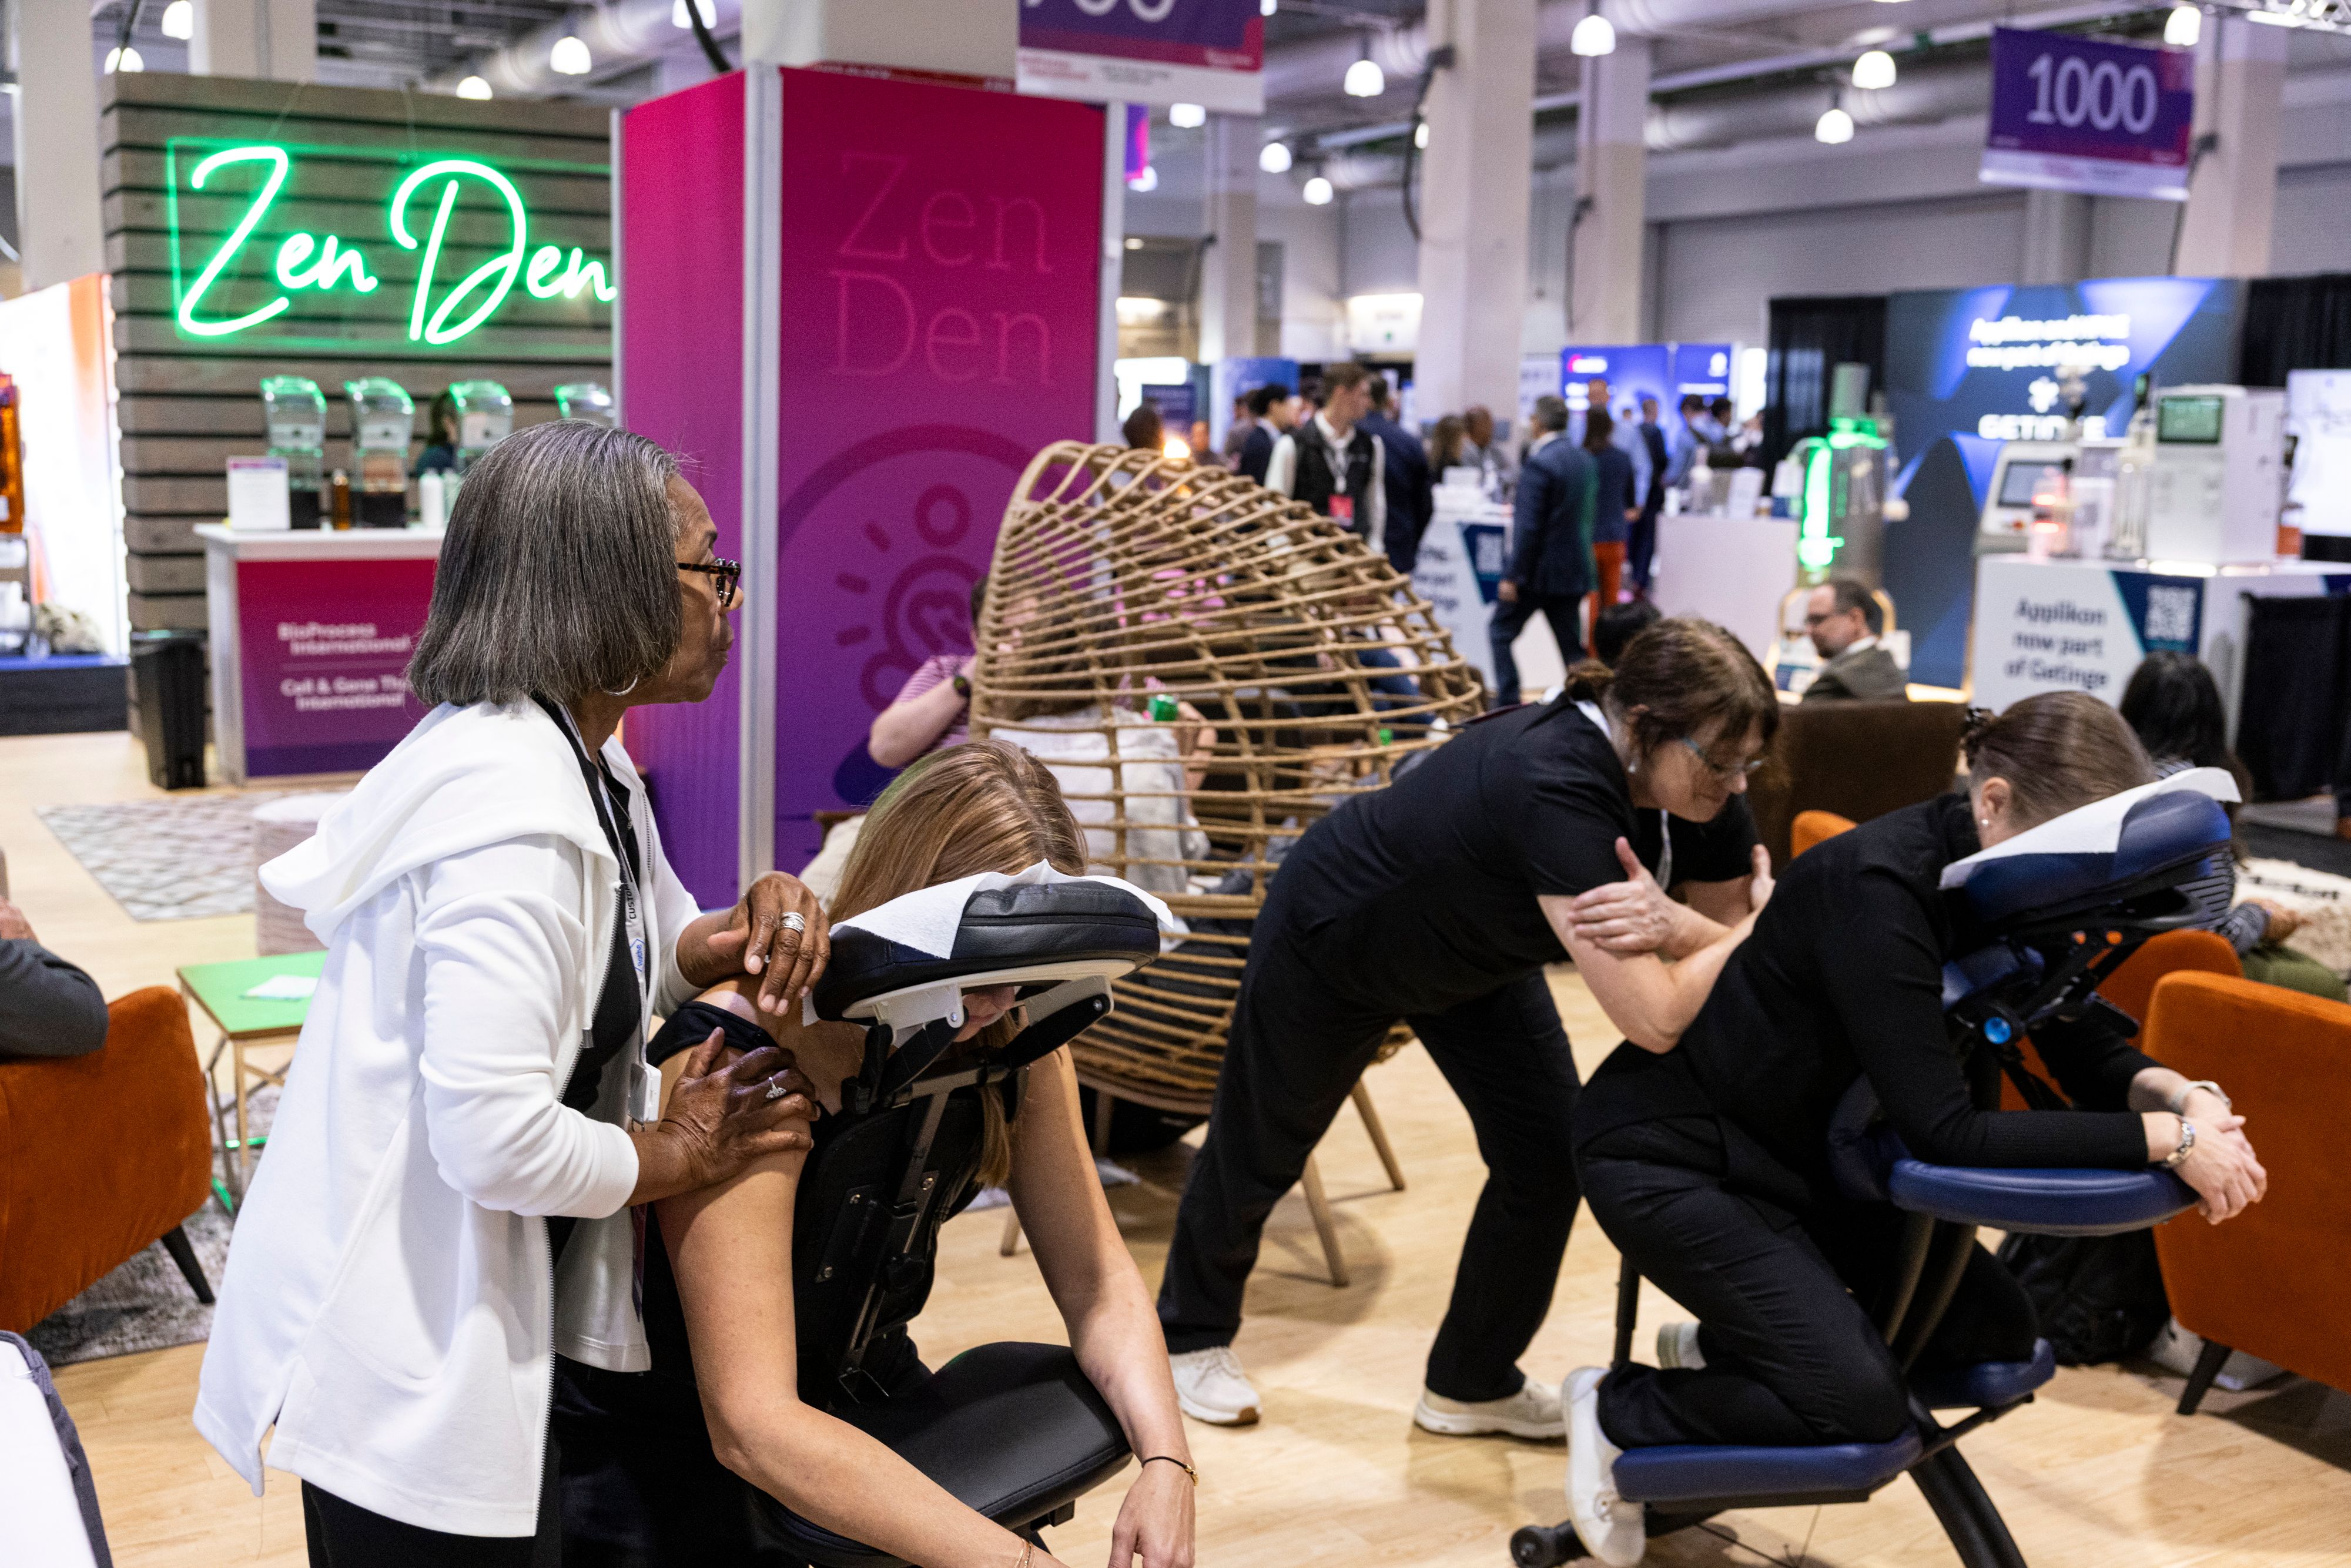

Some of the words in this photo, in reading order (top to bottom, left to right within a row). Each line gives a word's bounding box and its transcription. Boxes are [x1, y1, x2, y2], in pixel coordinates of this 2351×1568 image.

[2028, 54, 2157, 133] 1000
[838, 153, 1053, 272] Zen
[178, 146, 378, 336] Zen
[390, 159, 618, 345] Den
[828, 270, 1056, 386] Den
[1978, 414, 2106, 441] GETINE
[2015, 599, 2106, 624] Applikon
[2014, 632, 2054, 650] now
[2059, 637, 2102, 656] part
[2030, 659, 2109, 689] Getinge
